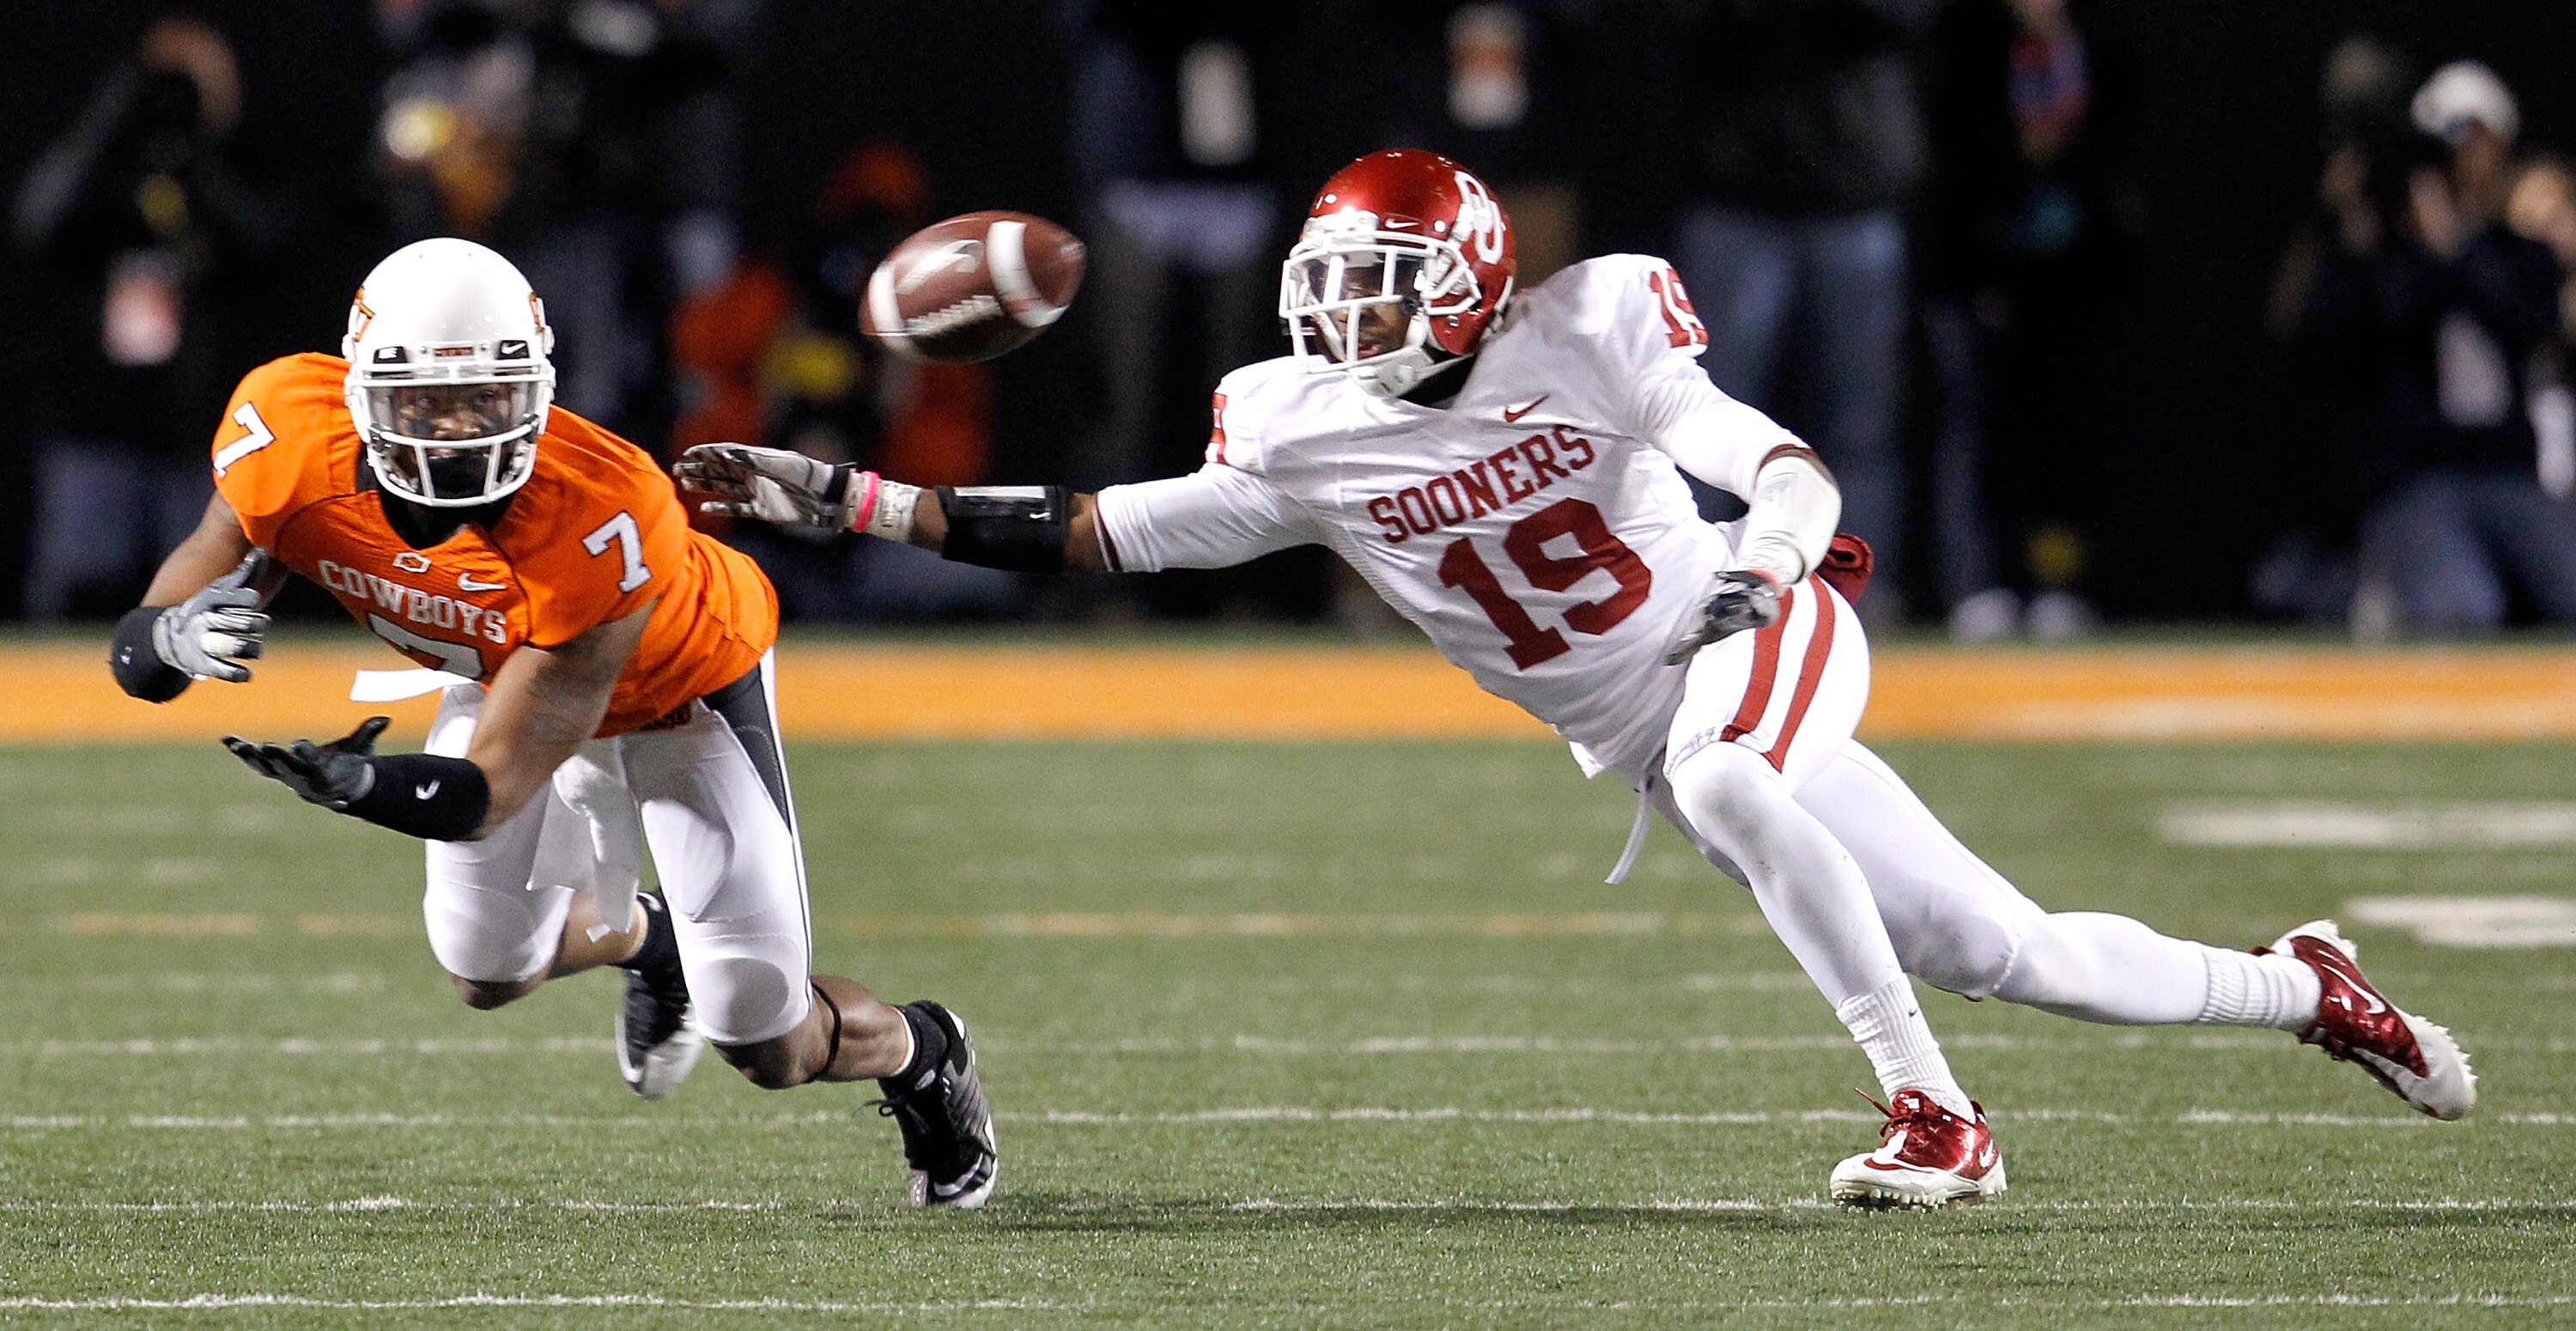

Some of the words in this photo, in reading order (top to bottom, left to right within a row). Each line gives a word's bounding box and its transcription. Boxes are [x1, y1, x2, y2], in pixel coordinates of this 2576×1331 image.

[1649, 267, 1709, 348] 19
[214, 401, 275, 477] 7
[1367, 426, 1596, 544] SOONERS
[583, 512, 651, 594] 7
[1438, 497, 1652, 672] 19
[318, 559, 507, 644] COWBOYS
